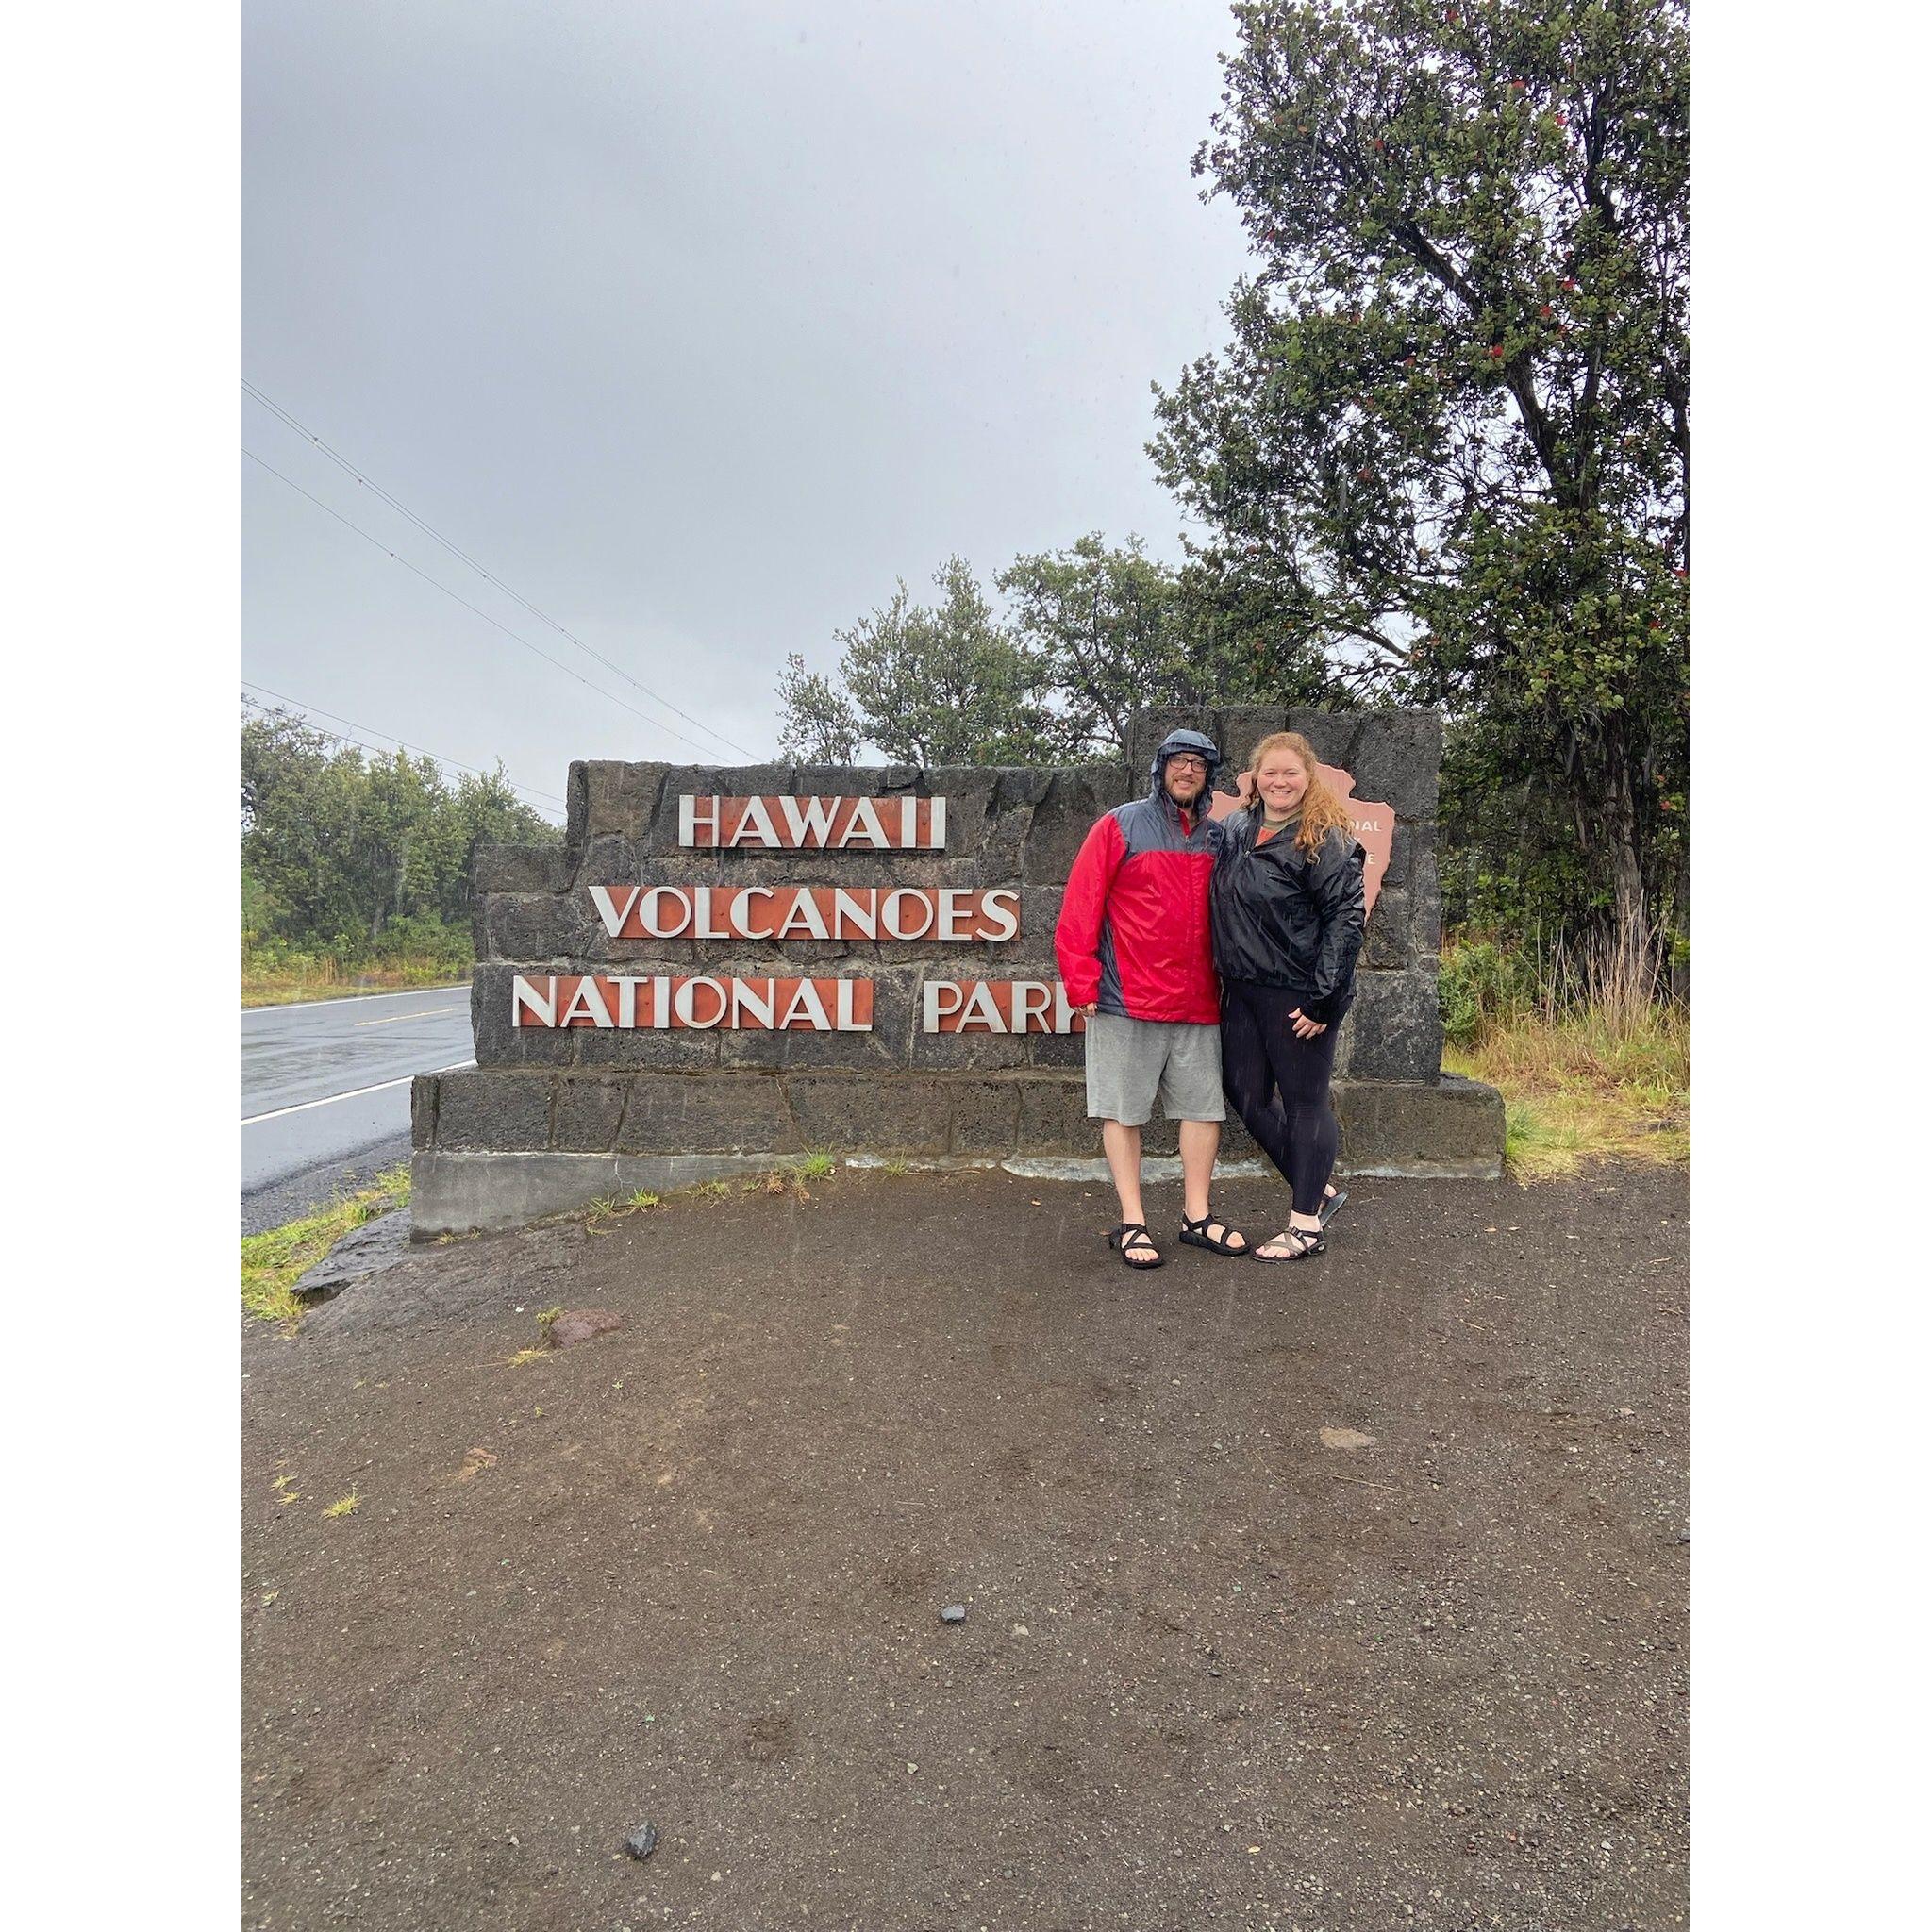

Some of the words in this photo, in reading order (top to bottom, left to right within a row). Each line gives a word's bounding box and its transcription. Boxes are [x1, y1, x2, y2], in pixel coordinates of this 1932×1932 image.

[678, 794, 946, 849] HAWAII
[588, 885, 1020, 941] VOLCANOES
[512, 974, 874, 1033] NATIONAL
